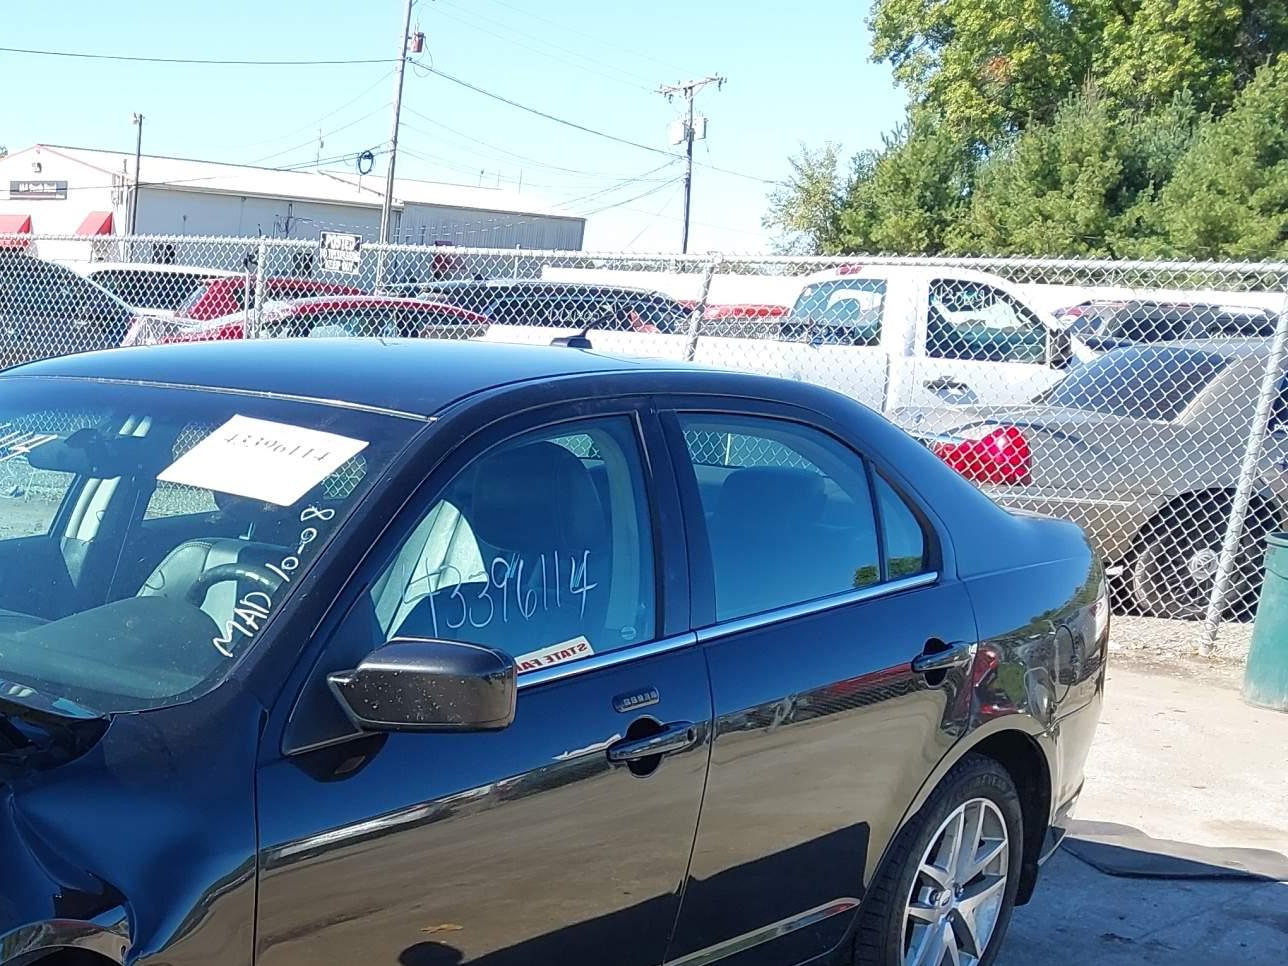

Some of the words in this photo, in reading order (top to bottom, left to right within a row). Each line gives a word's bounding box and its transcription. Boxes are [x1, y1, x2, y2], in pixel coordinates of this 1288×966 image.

[212, 592, 272, 658] MAD
[265, 506, 336, 583] 10-08
[402, 550, 598, 638] 43396114
